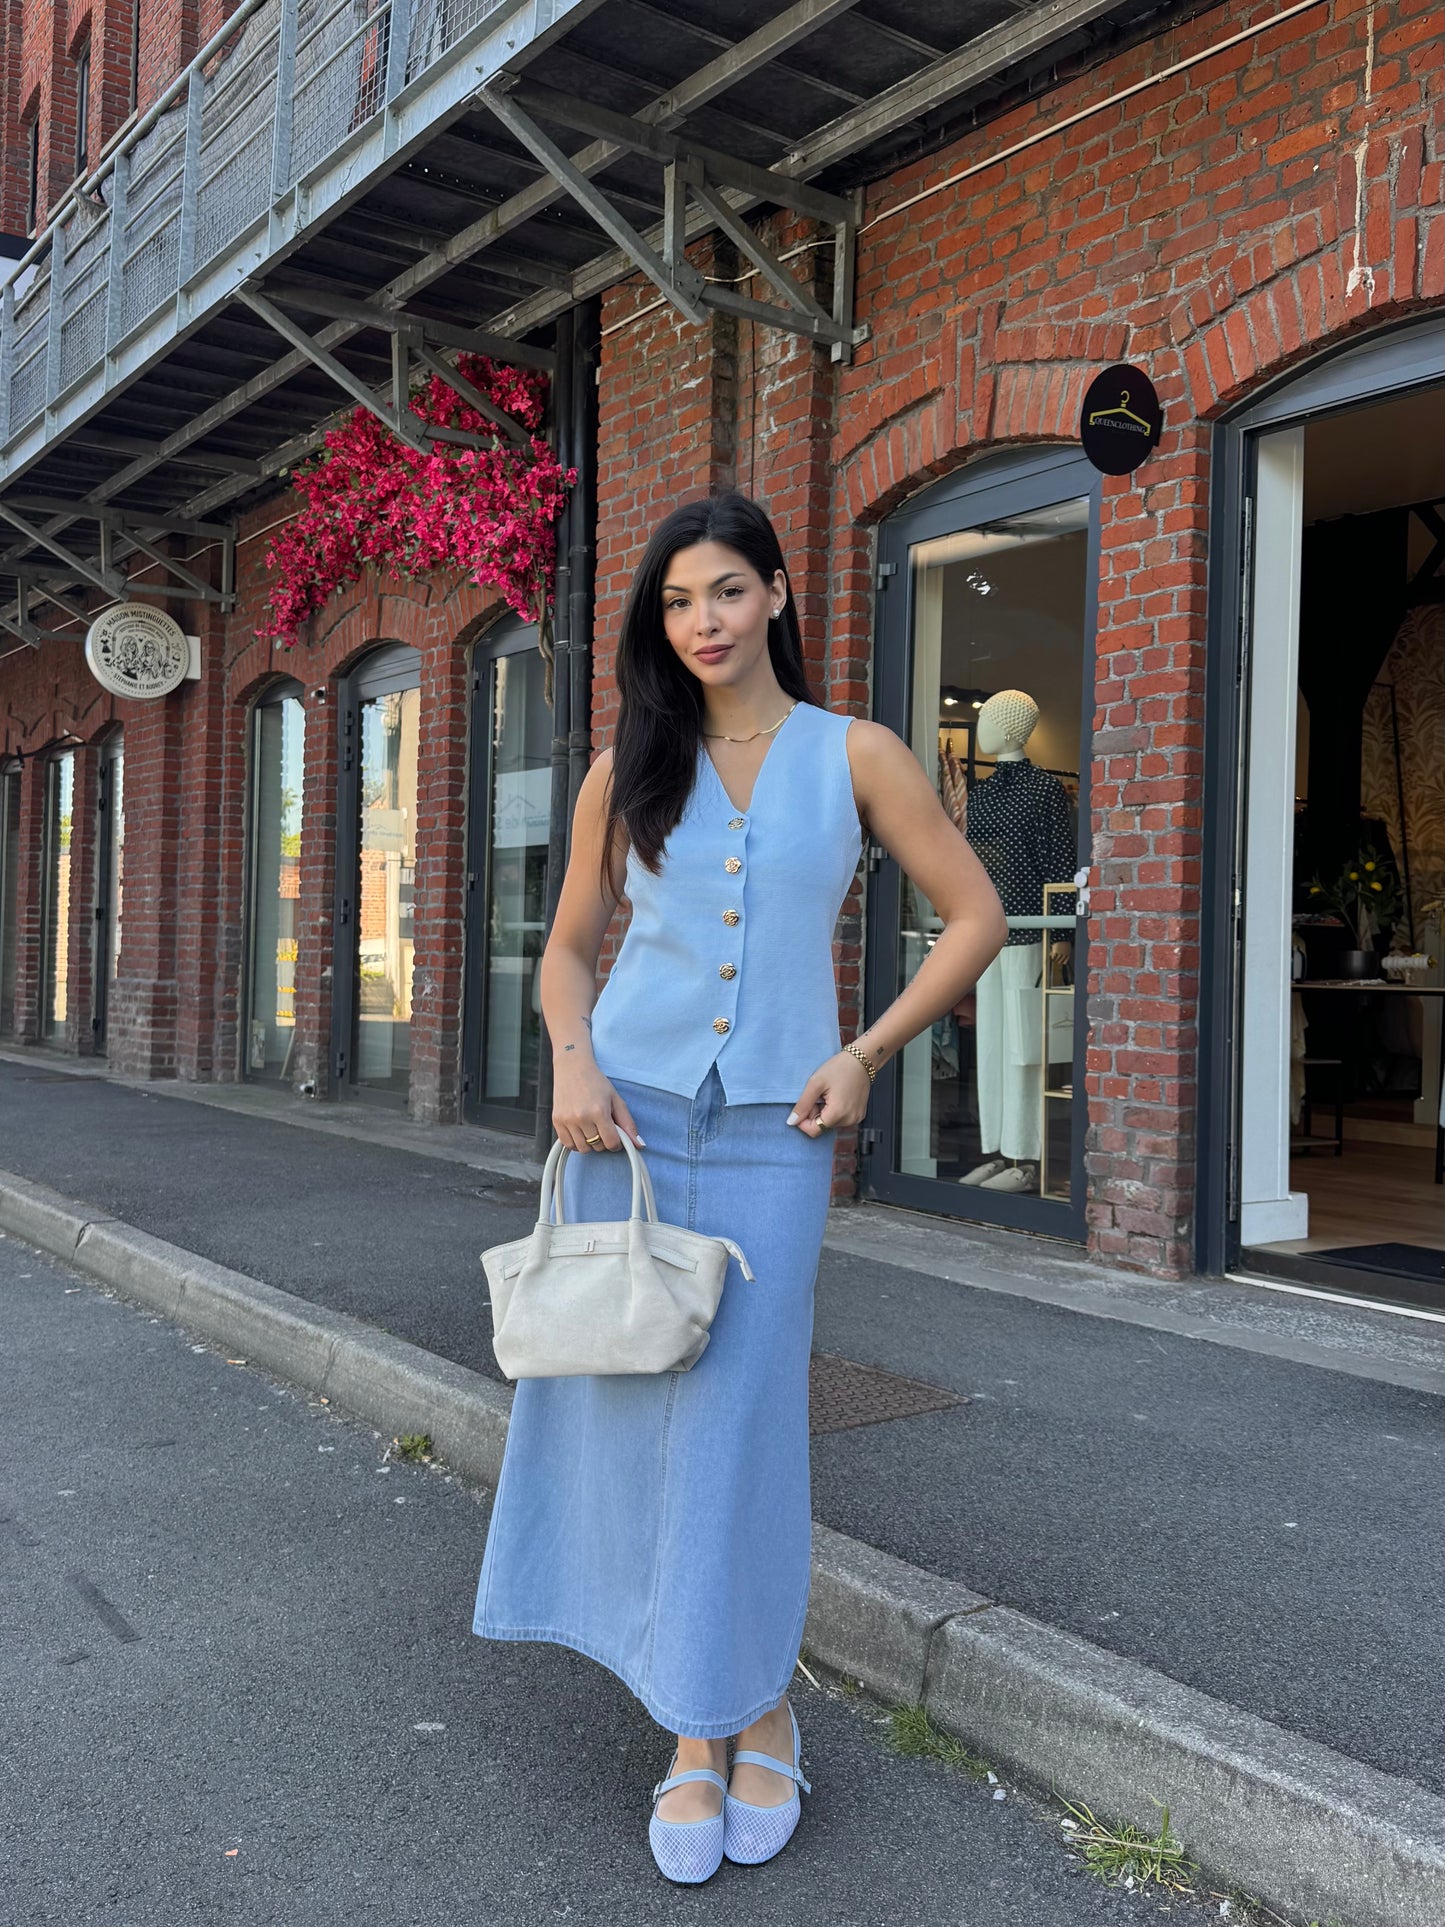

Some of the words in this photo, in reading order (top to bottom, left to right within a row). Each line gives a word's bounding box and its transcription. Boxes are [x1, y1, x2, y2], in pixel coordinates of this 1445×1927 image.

[1094, 417, 1146, 433] QUEENCLOTHING
[106, 611, 130, 627] MAISON
[130, 610, 177, 637] MISTINGUETTES
